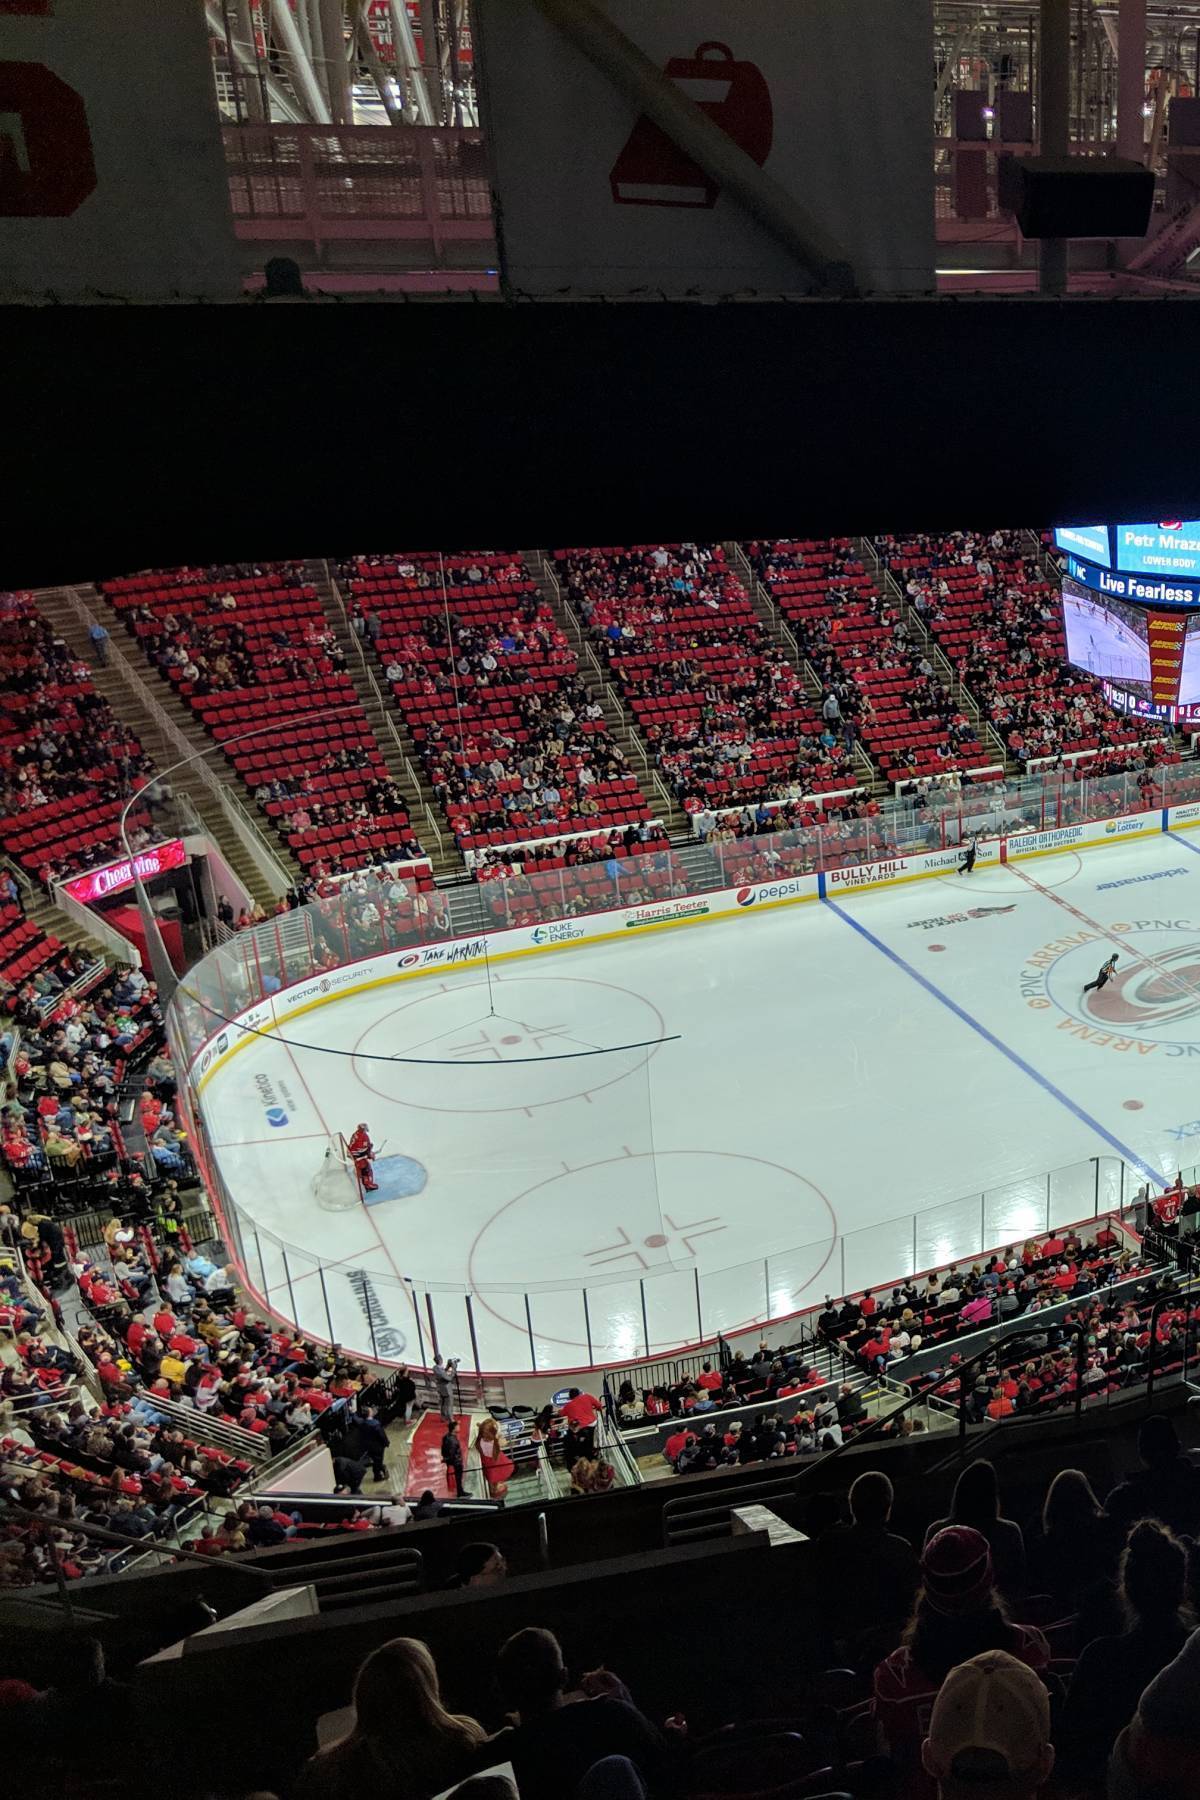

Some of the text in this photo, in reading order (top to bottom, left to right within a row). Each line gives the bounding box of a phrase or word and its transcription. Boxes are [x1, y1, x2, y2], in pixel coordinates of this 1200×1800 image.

[1125, 531, 1155, 548] Petr
[1143, 555, 1196, 569] LOWER BODY
[1076, 567, 1087, 581] NC
[1100, 572, 1125, 591] Live
[1128, 577, 1193, 602] Fearless
[1118, 821, 1144, 832] Lottery
[1009, 827, 1083, 849] RALEIGH ORTHOPAEDIC
[924, 855, 957, 869] Michael
[978, 850, 993, 858] Son
[831, 860, 908, 883] BULLY HILL
[845, 872, 896, 887] VINEYARDS
[1096, 867, 1189, 891] ticketmaster
[759, 881, 800, 901] pepsi
[636, 900, 708, 919] Harris Teeter
[549, 922, 573, 934] DUKE
[907, 916, 946, 928] TICKET
[936, 916, 968, 926] CLICK
[1135, 919, 1191, 931] PNC
[550, 929, 585, 942] ENERGY
[421, 947, 446, 963] TAKE
[1020, 931, 1097, 998] PNC ARENA
[287, 967, 373, 1003] VECTOR SECURITY
[1056, 1018, 1158, 1055] ARENA
[255, 1074, 279, 1107] Kinetico
